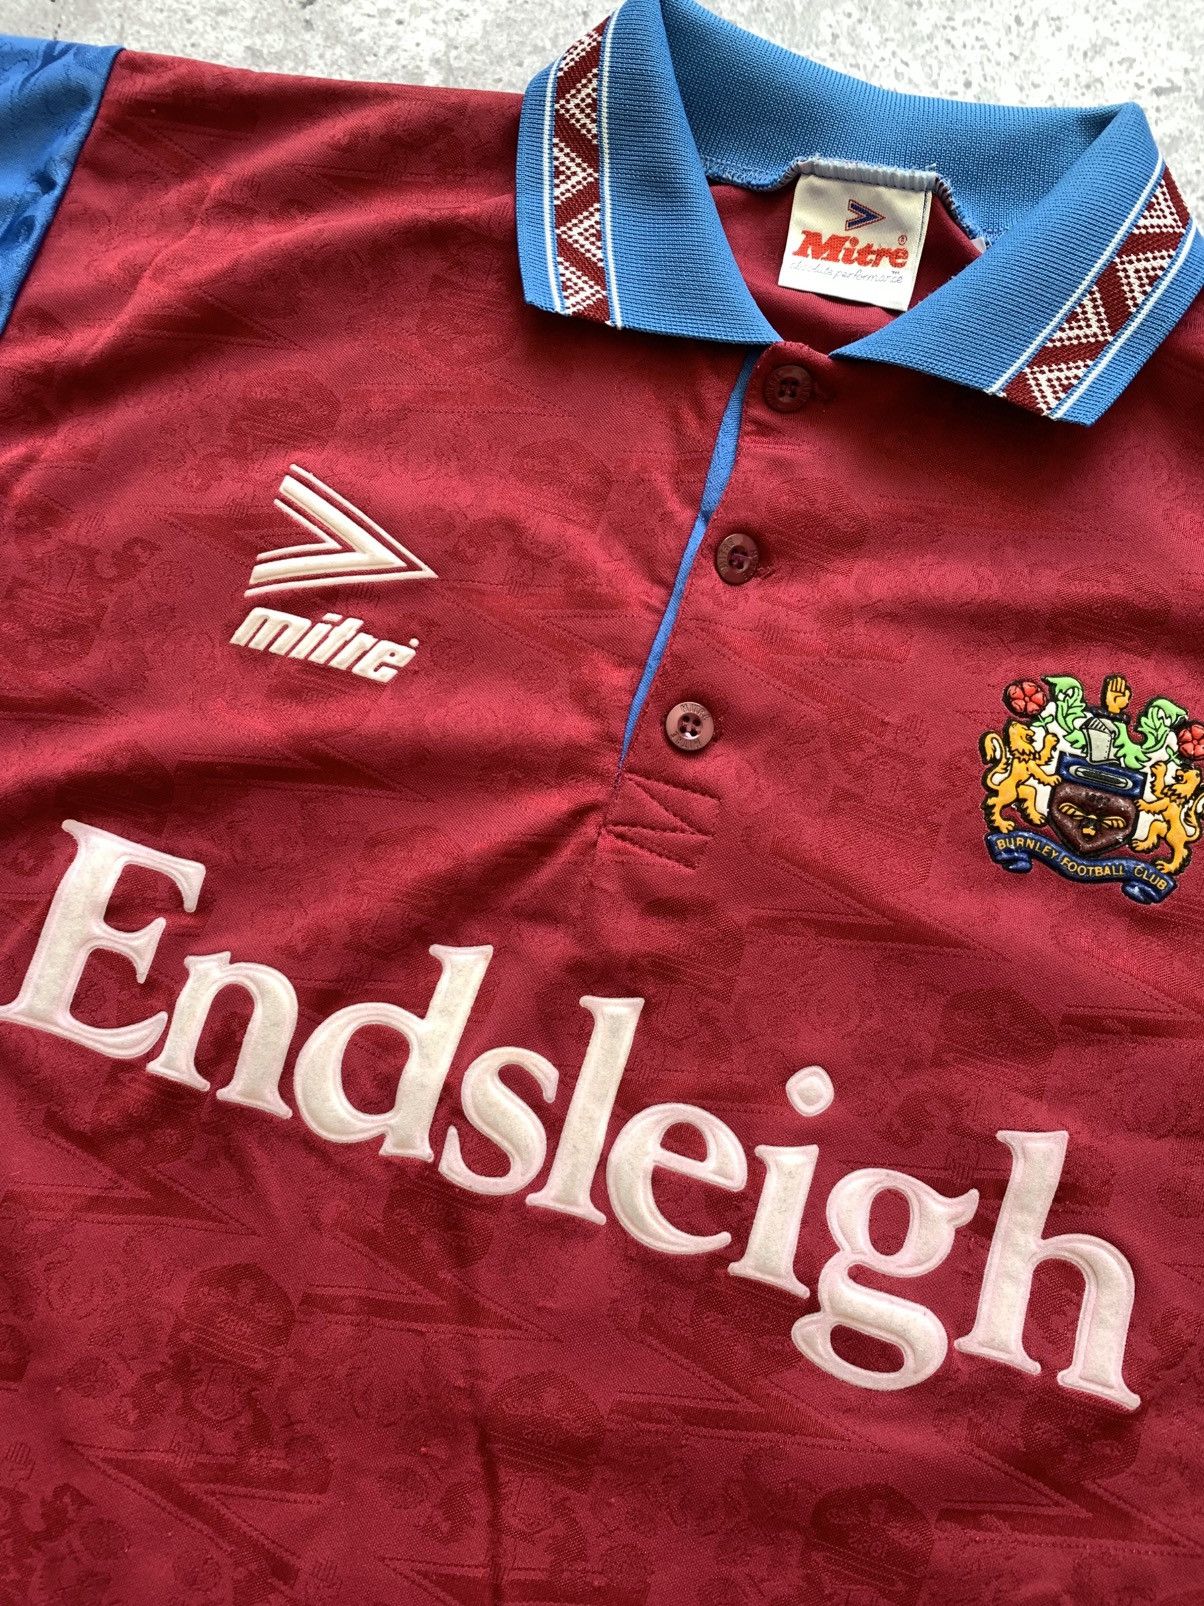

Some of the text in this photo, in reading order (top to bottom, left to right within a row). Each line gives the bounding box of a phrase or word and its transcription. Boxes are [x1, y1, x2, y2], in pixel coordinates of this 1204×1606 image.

[230, 607, 417, 683] mitre
[996, 838, 1169, 890] BURNLEY FOOTBALL CLUB
[0, 819, 1141, 1411] Endsleigh
